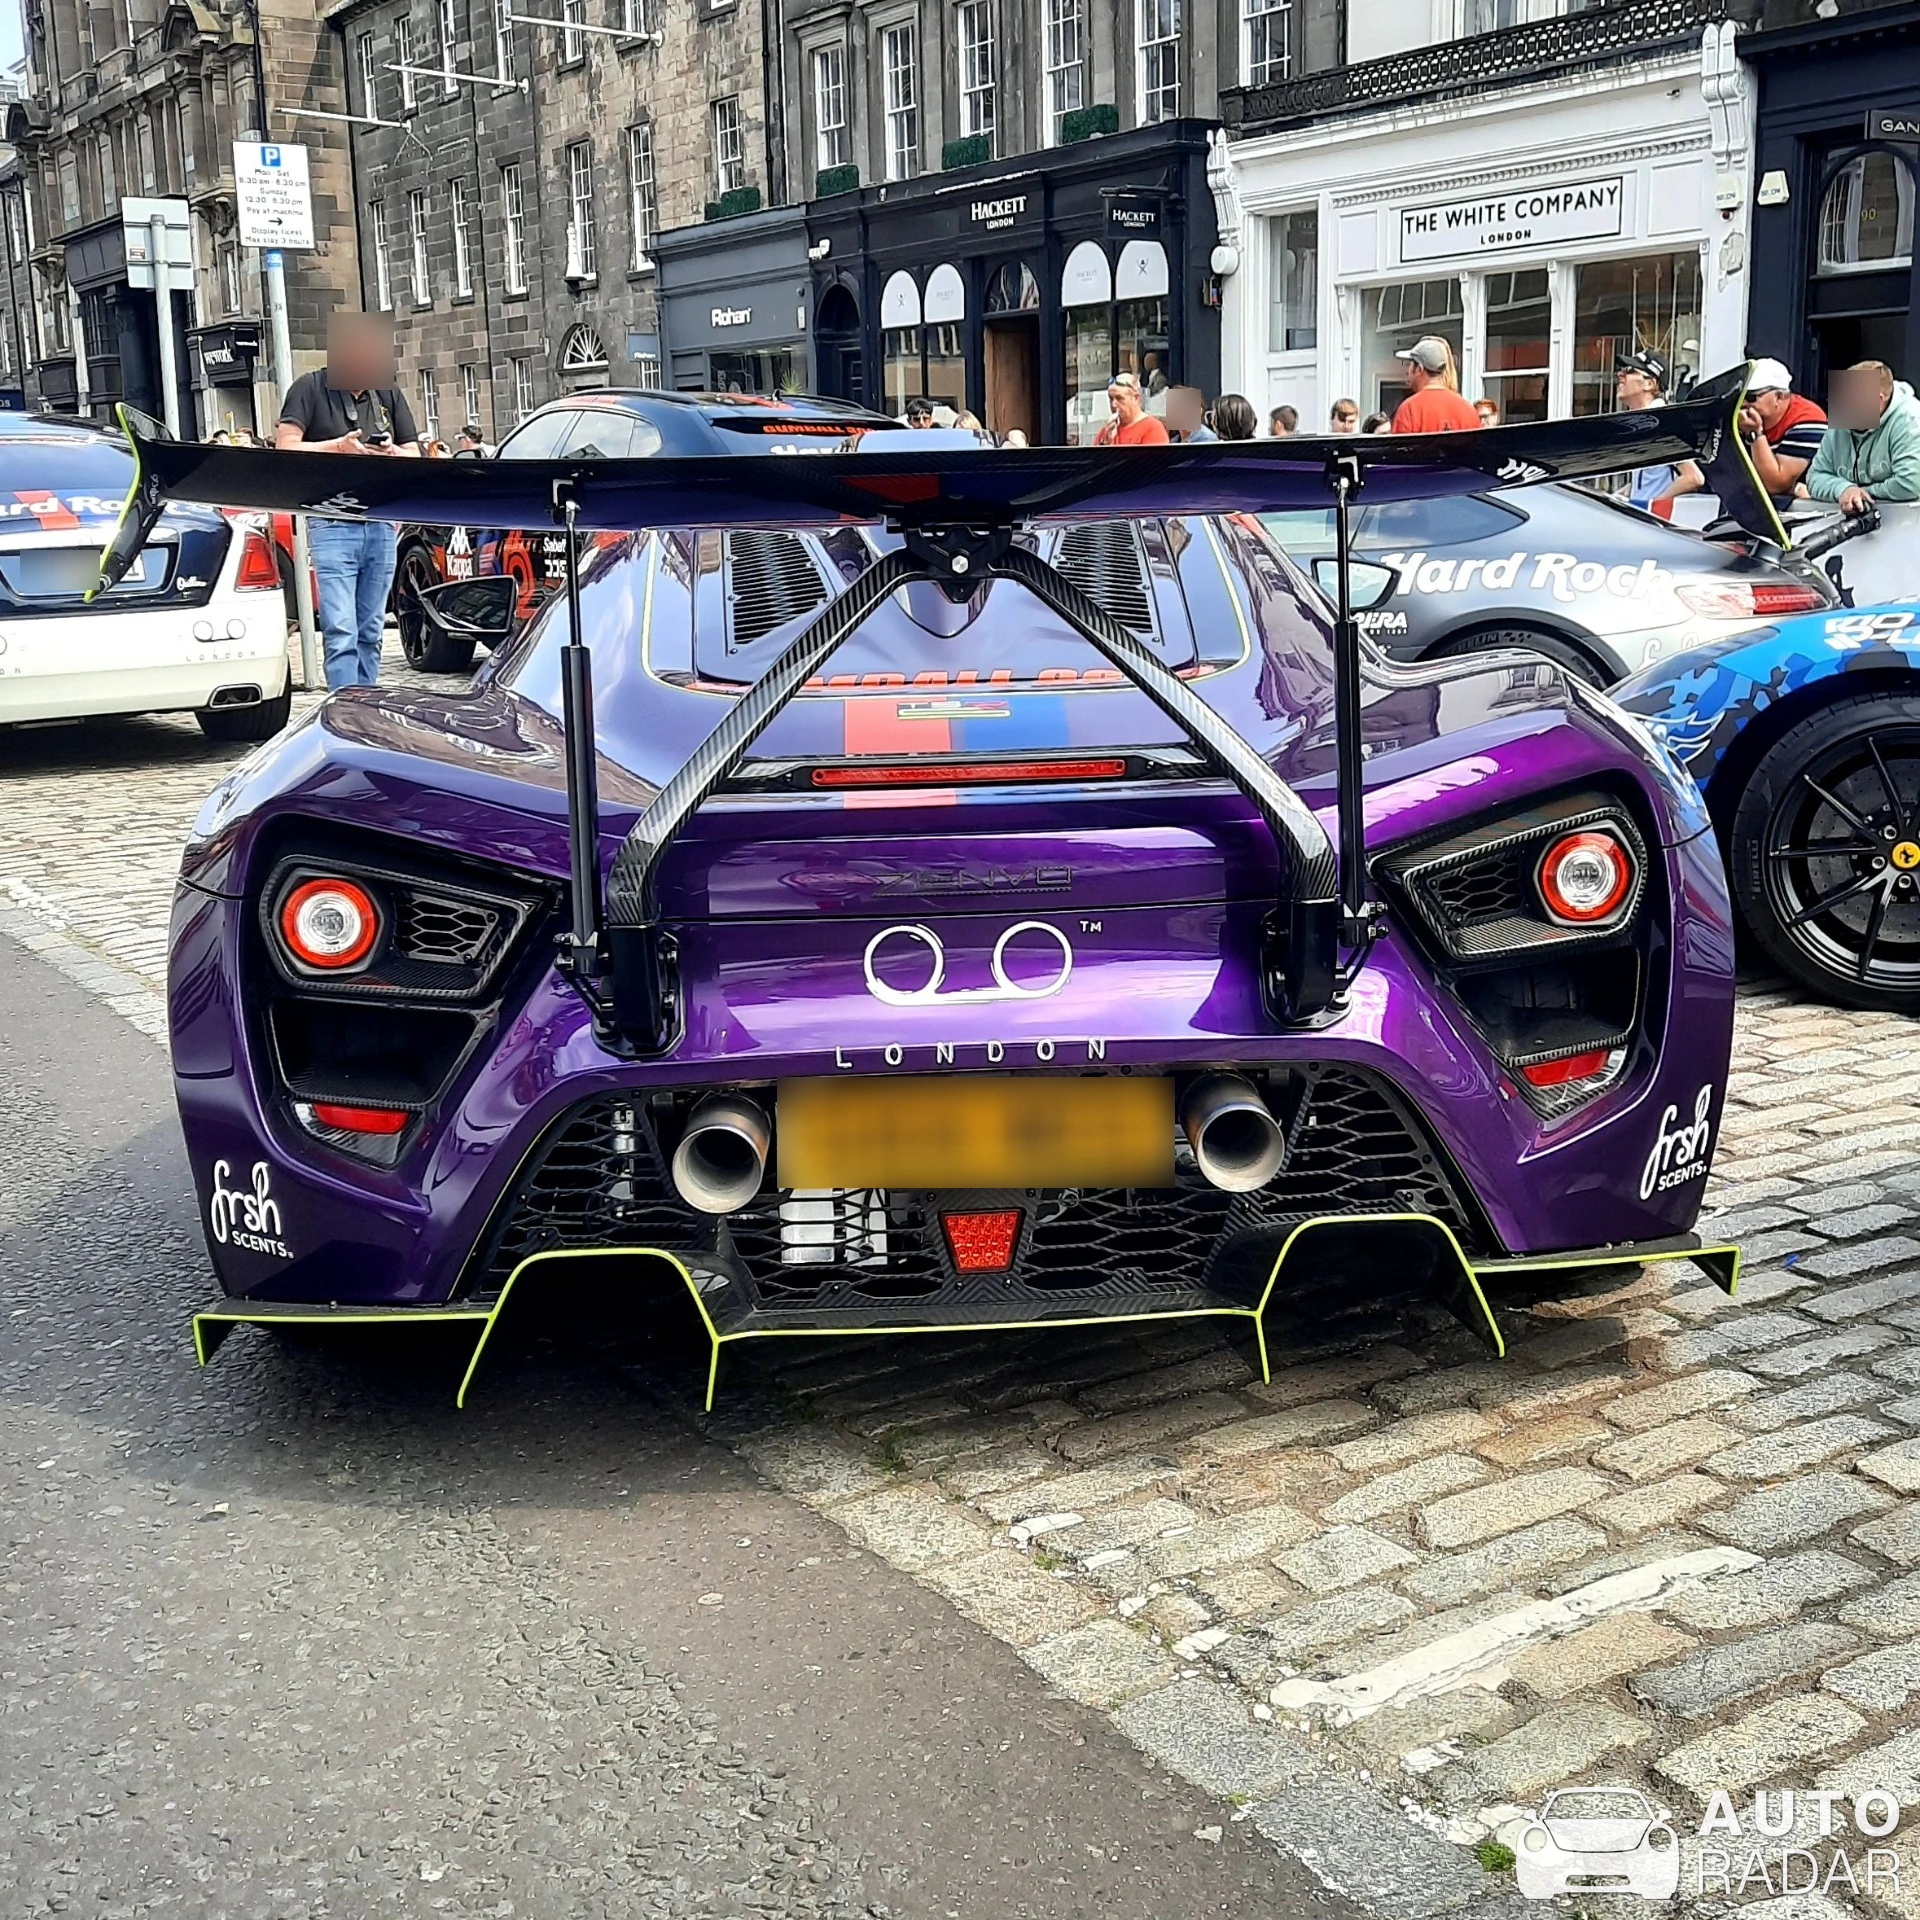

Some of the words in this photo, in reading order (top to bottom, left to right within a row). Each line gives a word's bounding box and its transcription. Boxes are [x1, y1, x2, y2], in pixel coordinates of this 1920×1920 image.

[1881, 119, 1920, 133] GAN
[260, 188, 287, 196] Sunday
[247, 206, 260, 215] Pay
[971, 196, 1027, 221] HACKETT
[1112, 209, 1155, 222] HACKETT
[1405, 212, 1437, 234] THE
[1446, 203, 1506, 228] WHITE
[1515, 186, 1618, 219] COMPANY
[1861, 208, 1876, 221] 90
[986, 216, 1014, 230] LONDON
[1480, 229, 1532, 245] LONDON
[711, 306, 752, 328] Rohan
[763, 425, 845, 434] GUMBALL
[447, 555, 473, 581] Kappa
[1380, 552, 1527, 595] Hard
[1530, 552, 1673, 602] Rock
[186, 651, 256, 662] LONDON
[872, 866, 1071, 896] ZENVO
[1080, 920, 1102, 933] TM
[836, 1038, 1105, 1067] LONDON
[1640, 1084, 1713, 1200] frsh
[211, 1160, 282, 1243] frsh
